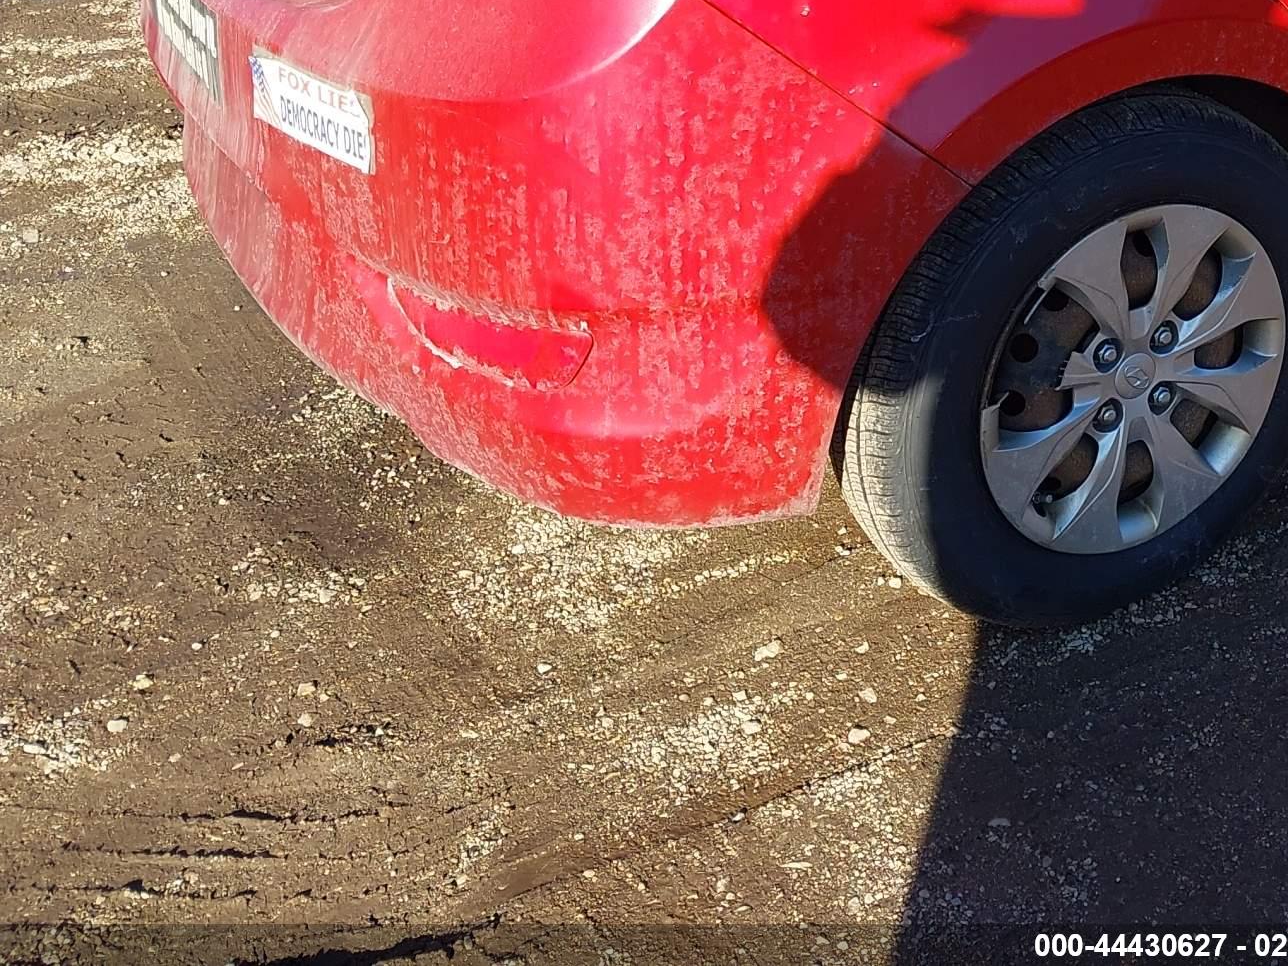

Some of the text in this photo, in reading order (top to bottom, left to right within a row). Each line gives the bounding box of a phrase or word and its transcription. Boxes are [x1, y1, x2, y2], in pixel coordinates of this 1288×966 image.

[279, 65, 311, 97] FOX
[280, 94, 368, 161] DEMOCRACY DIE
